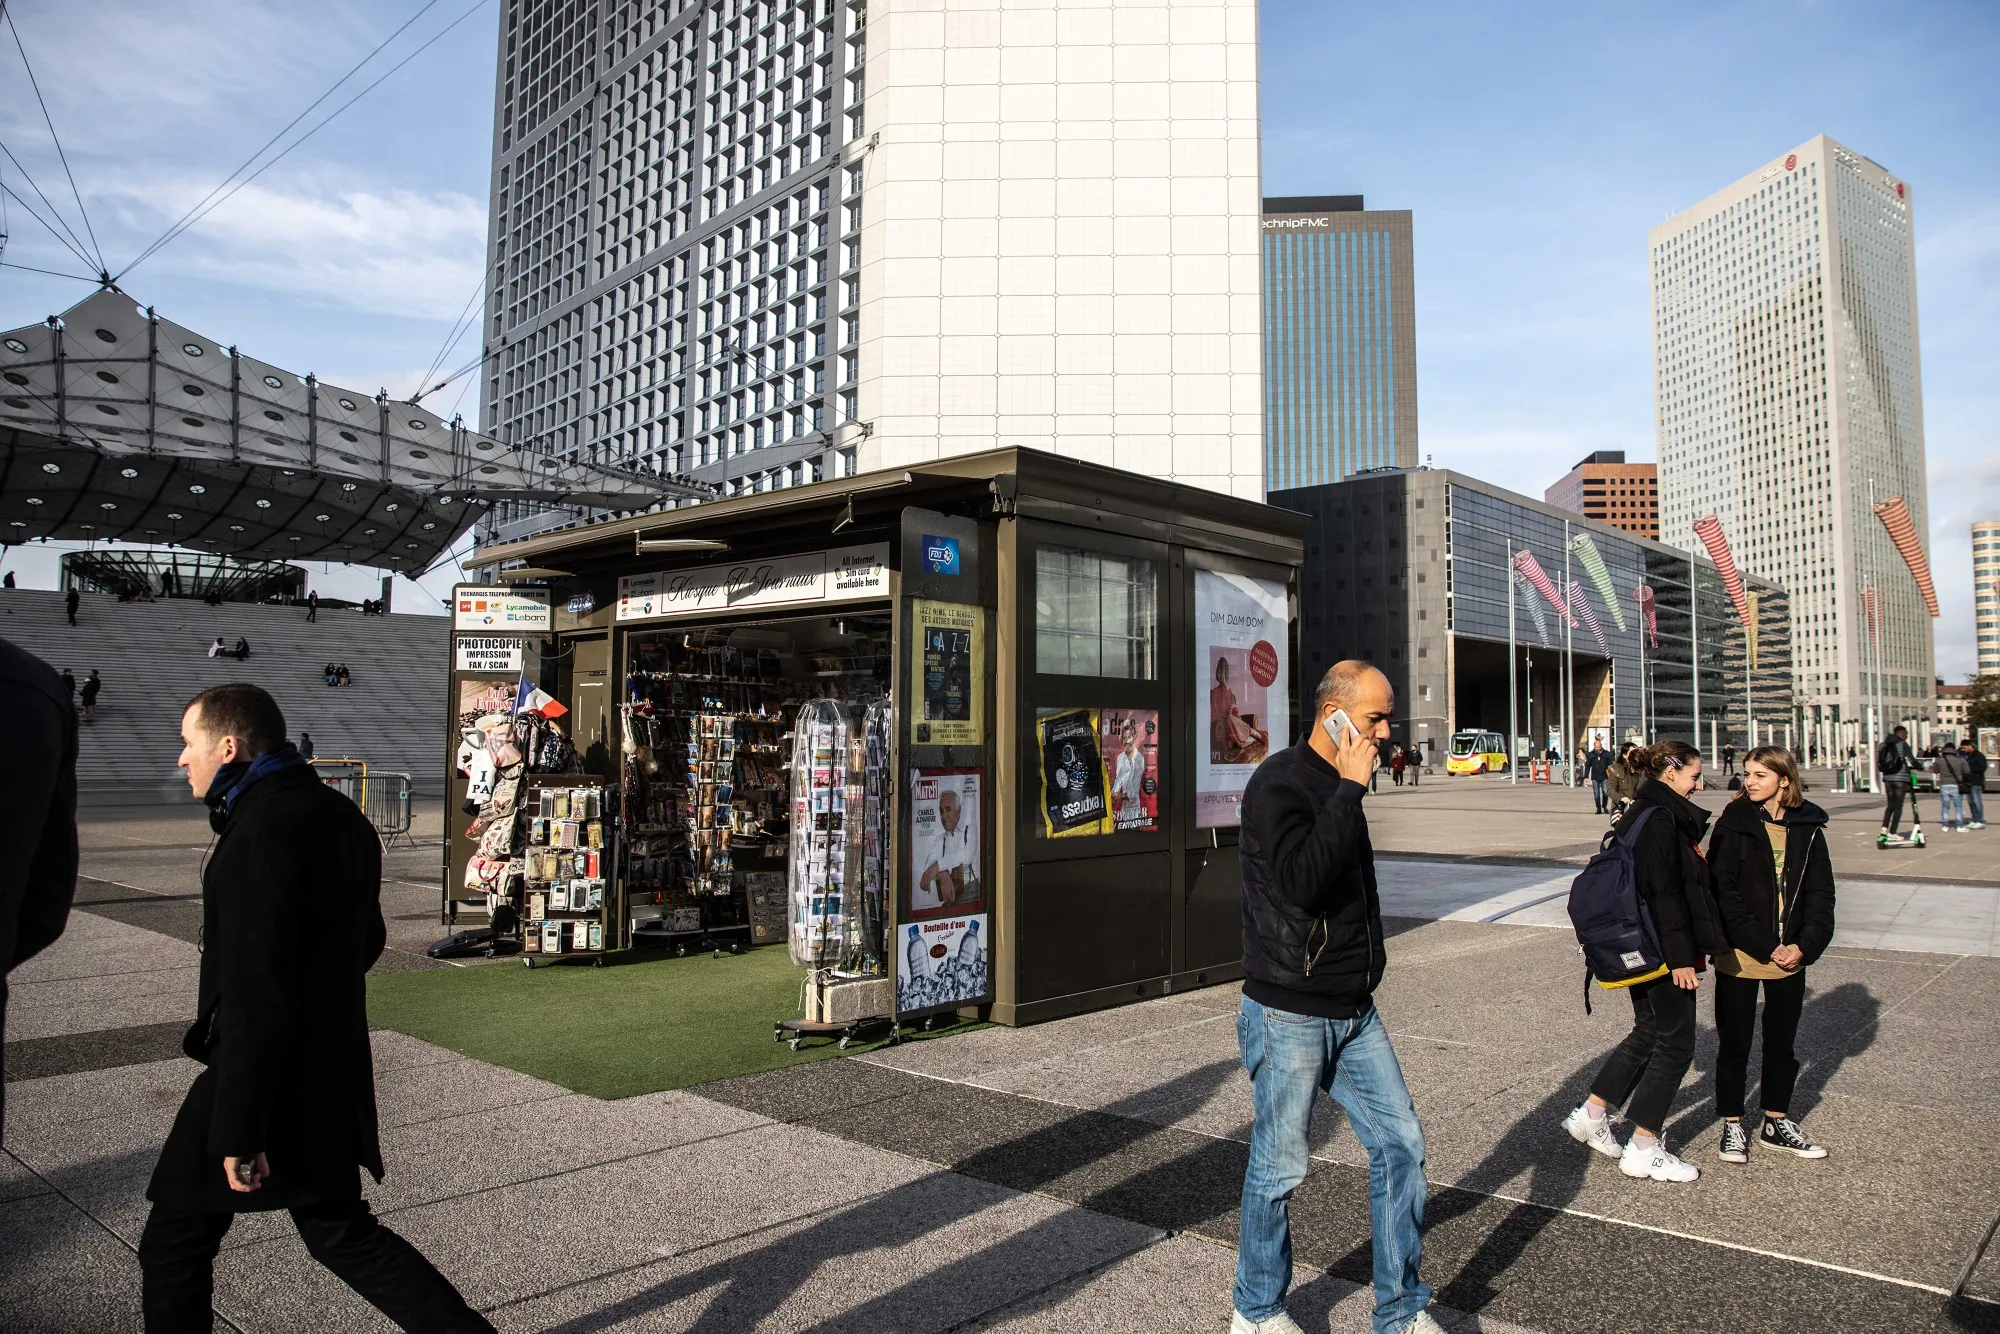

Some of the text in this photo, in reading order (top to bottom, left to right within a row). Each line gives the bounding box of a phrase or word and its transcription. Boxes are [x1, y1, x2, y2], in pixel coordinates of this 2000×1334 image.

[1262, 217, 1329, 229] echnipFMC
[852, 554, 875, 565] Internet
[931, 550, 942, 558] FDJ
[858, 565, 870, 576] card
[668, 575, 719, 606] Kiosque
[750, 565, 819, 596] Journaux
[837, 577, 879, 589] available here
[514, 613, 546, 621] Lebara
[1210, 611, 1264, 628] DIM DAM DOM
[457, 639, 522, 649] PHOTOCOPIE
[466, 651, 511, 659] IMPRESSION
[469, 661, 482, 669] FAX
[489, 661, 509, 669] SCAN
[1252, 655, 1276, 673] MAGAZINE
[487, 686, 509, 698] Café
[472, 784, 491, 794] PA
[915, 780, 938, 800] MATCH
[1203, 795, 1234, 803] APPUYEZ
[917, 808, 935, 816] CHARLES
[923, 920, 966, 933] Bouteille d'eau
